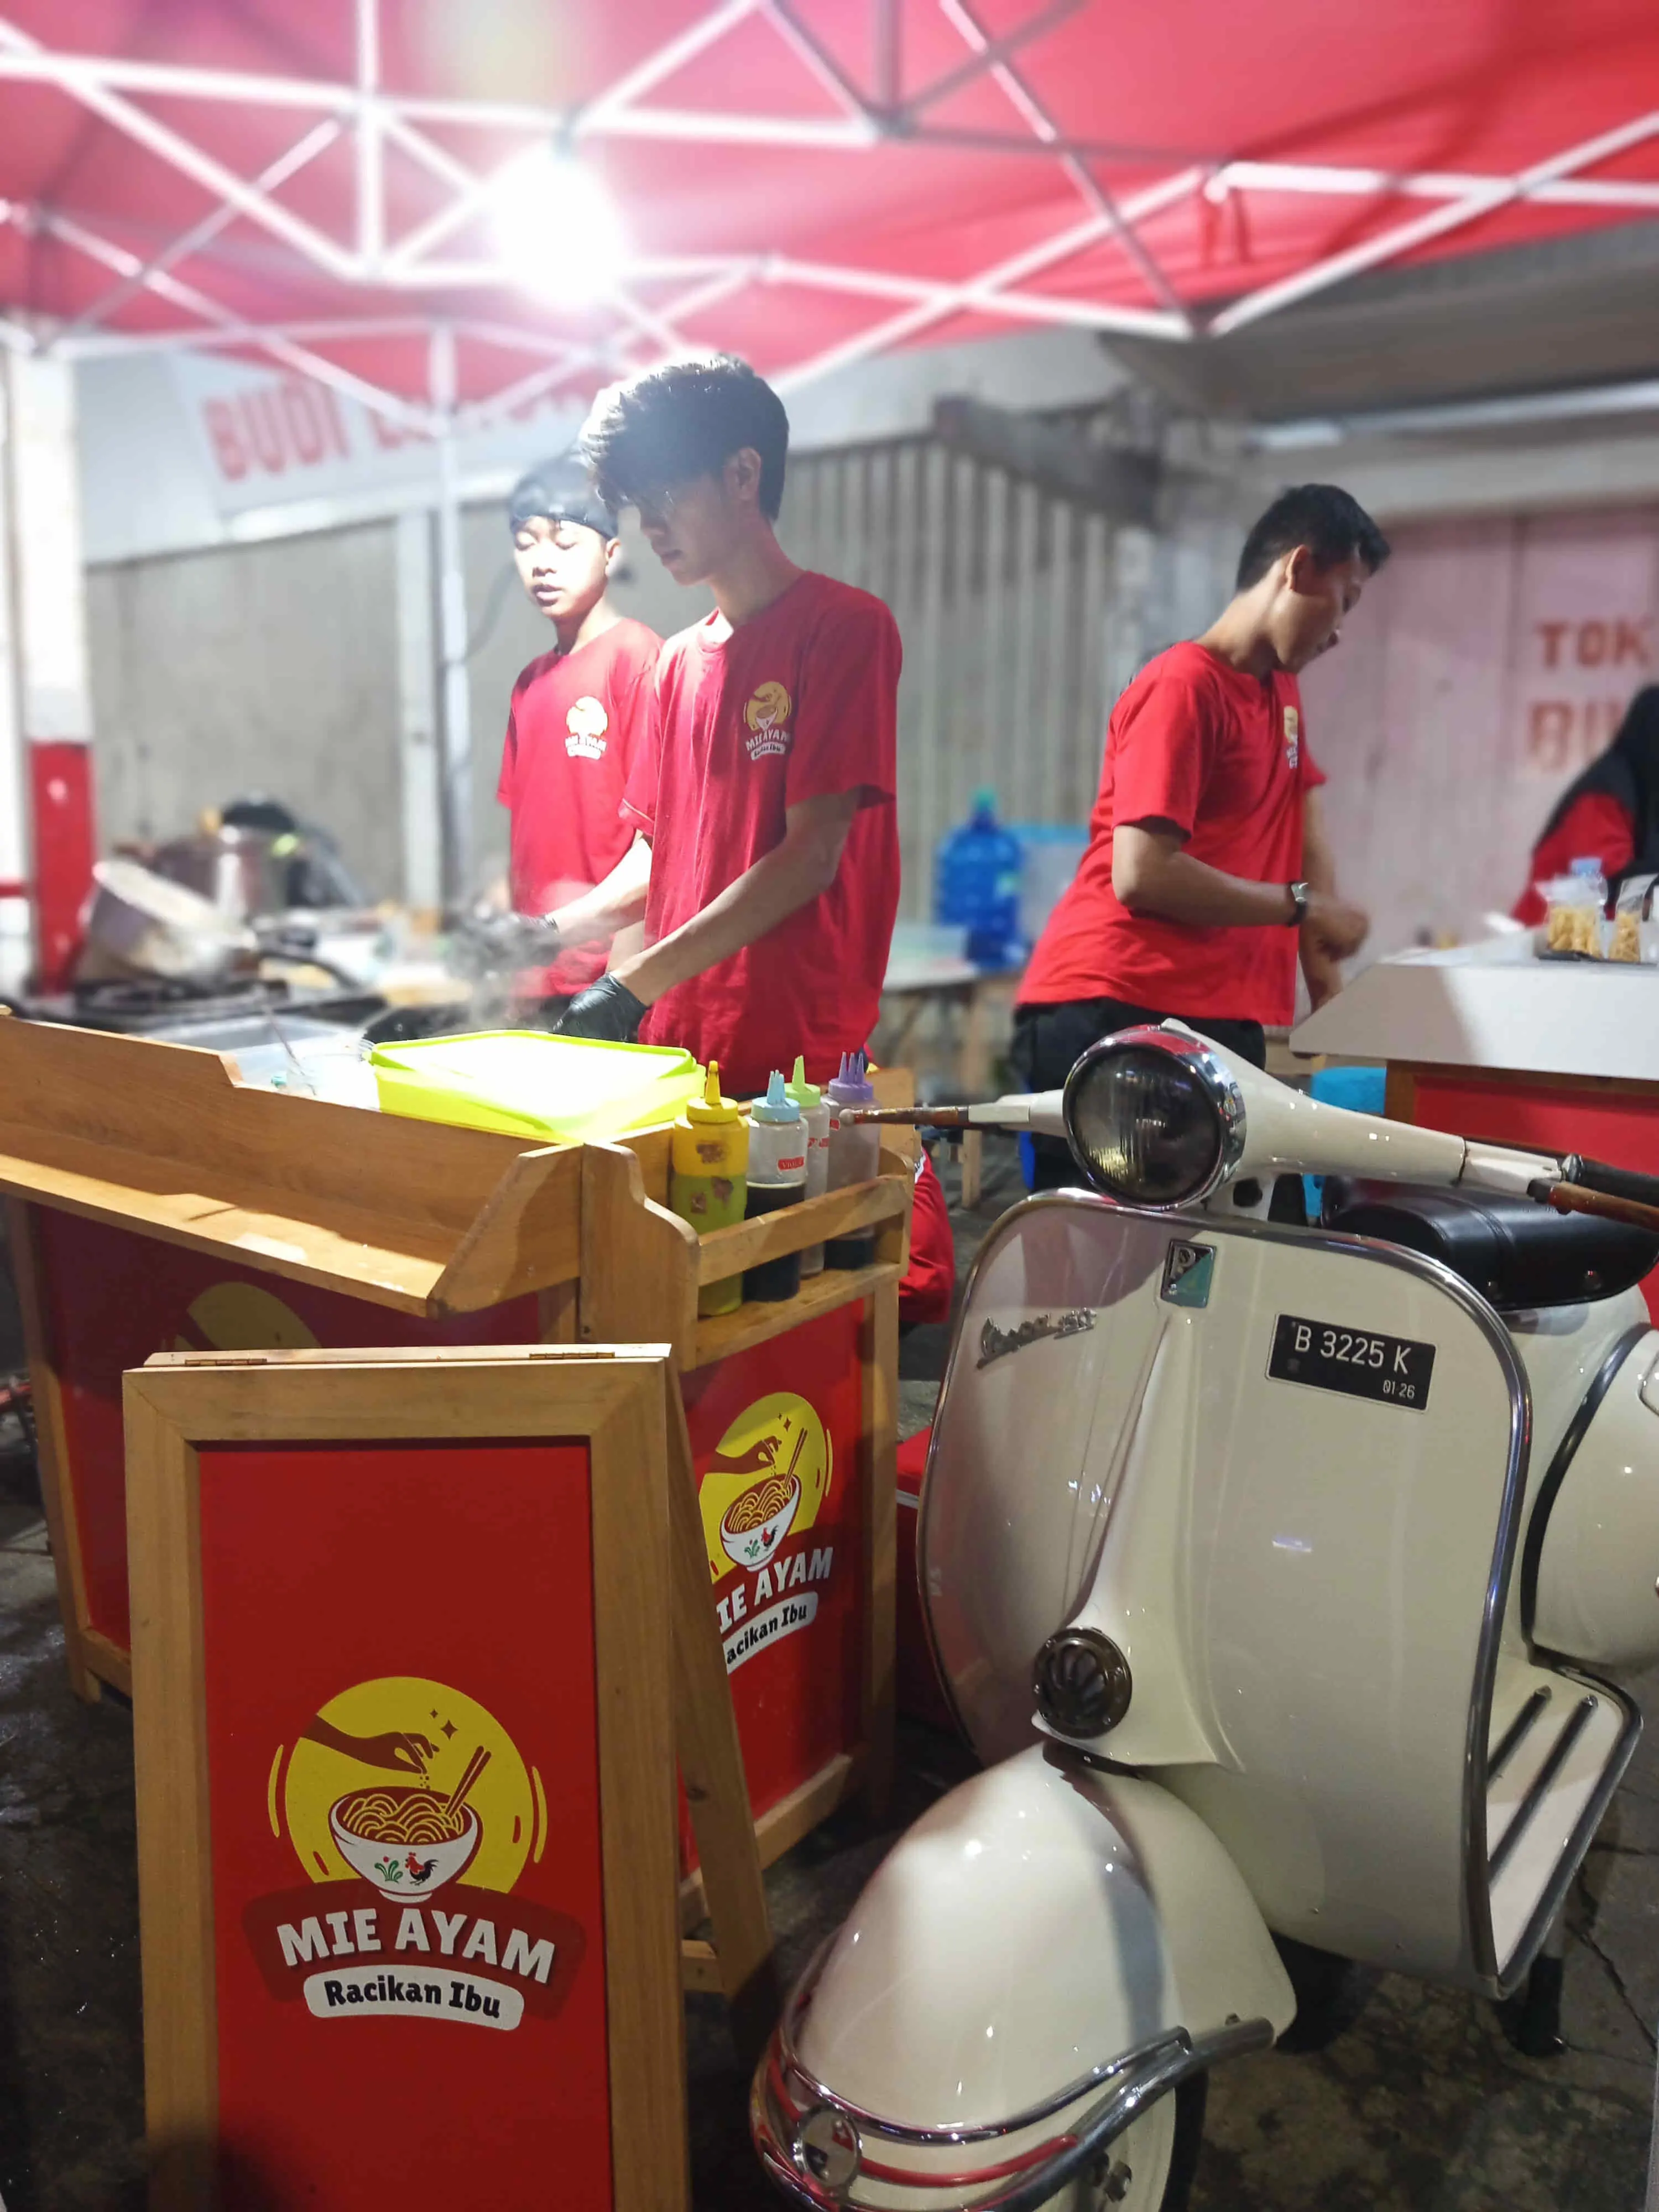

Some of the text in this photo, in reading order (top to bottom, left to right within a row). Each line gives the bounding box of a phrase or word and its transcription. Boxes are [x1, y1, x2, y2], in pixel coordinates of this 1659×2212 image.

[1295, 1325, 1412, 1375] B 3225 K
[716, 1547, 833, 1634] IE AYAM
[727, 1604, 807, 1664] acikan Ibu
[276, 1908, 555, 1984] MIE AYAM
[324, 1975, 500, 2019] Racikan Ibu
